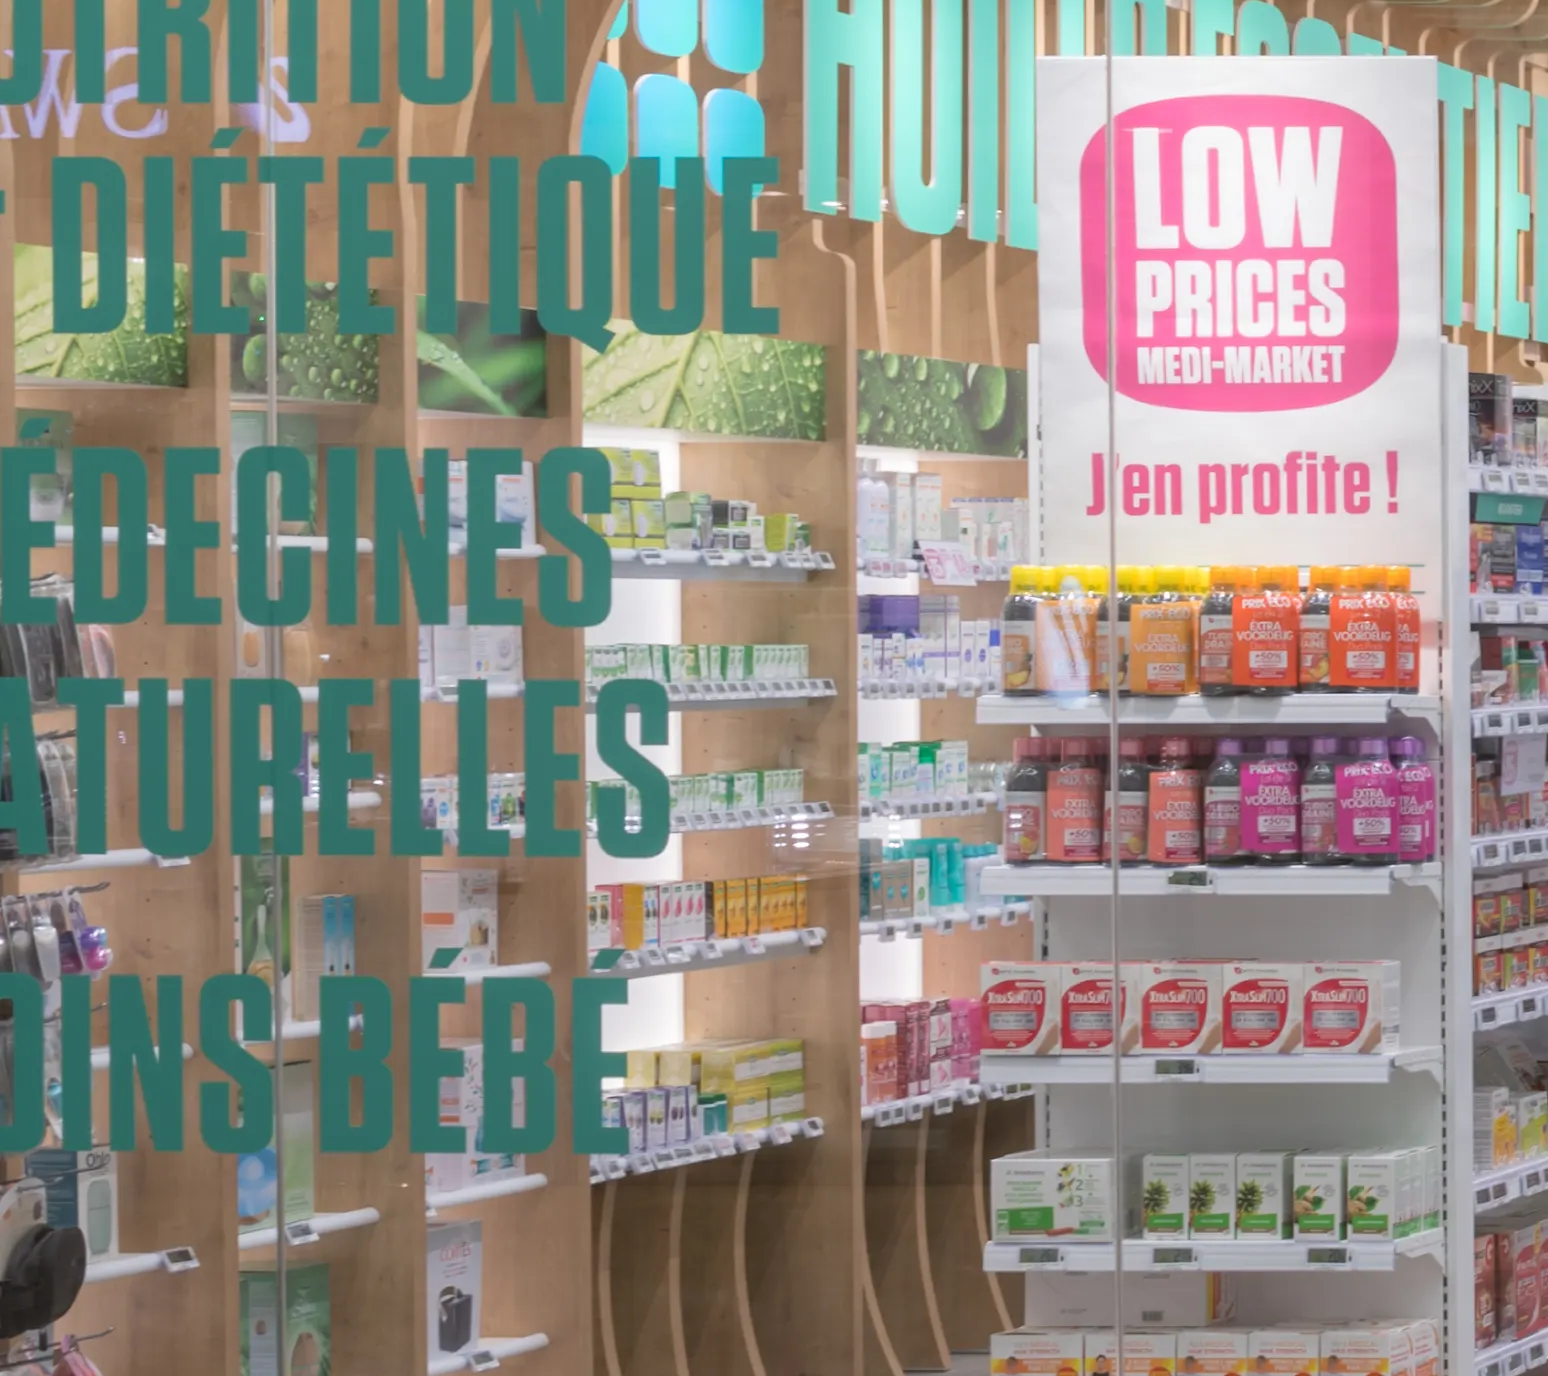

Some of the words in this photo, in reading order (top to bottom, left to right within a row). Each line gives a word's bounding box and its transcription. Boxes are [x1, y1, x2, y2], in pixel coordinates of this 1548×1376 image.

[1133, 125, 1342, 249] LOW
[52, 128, 780, 354] DIÉTÉTIQUE
[1136, 259, 1346, 338] PRICES
[1138, 345, 1345, 385] MEDI-MARKET
[1199, 451, 1370, 524] profite
[1386, 451, 1398, 513] !
[319, 949, 629, 1154] BÉBÉ
